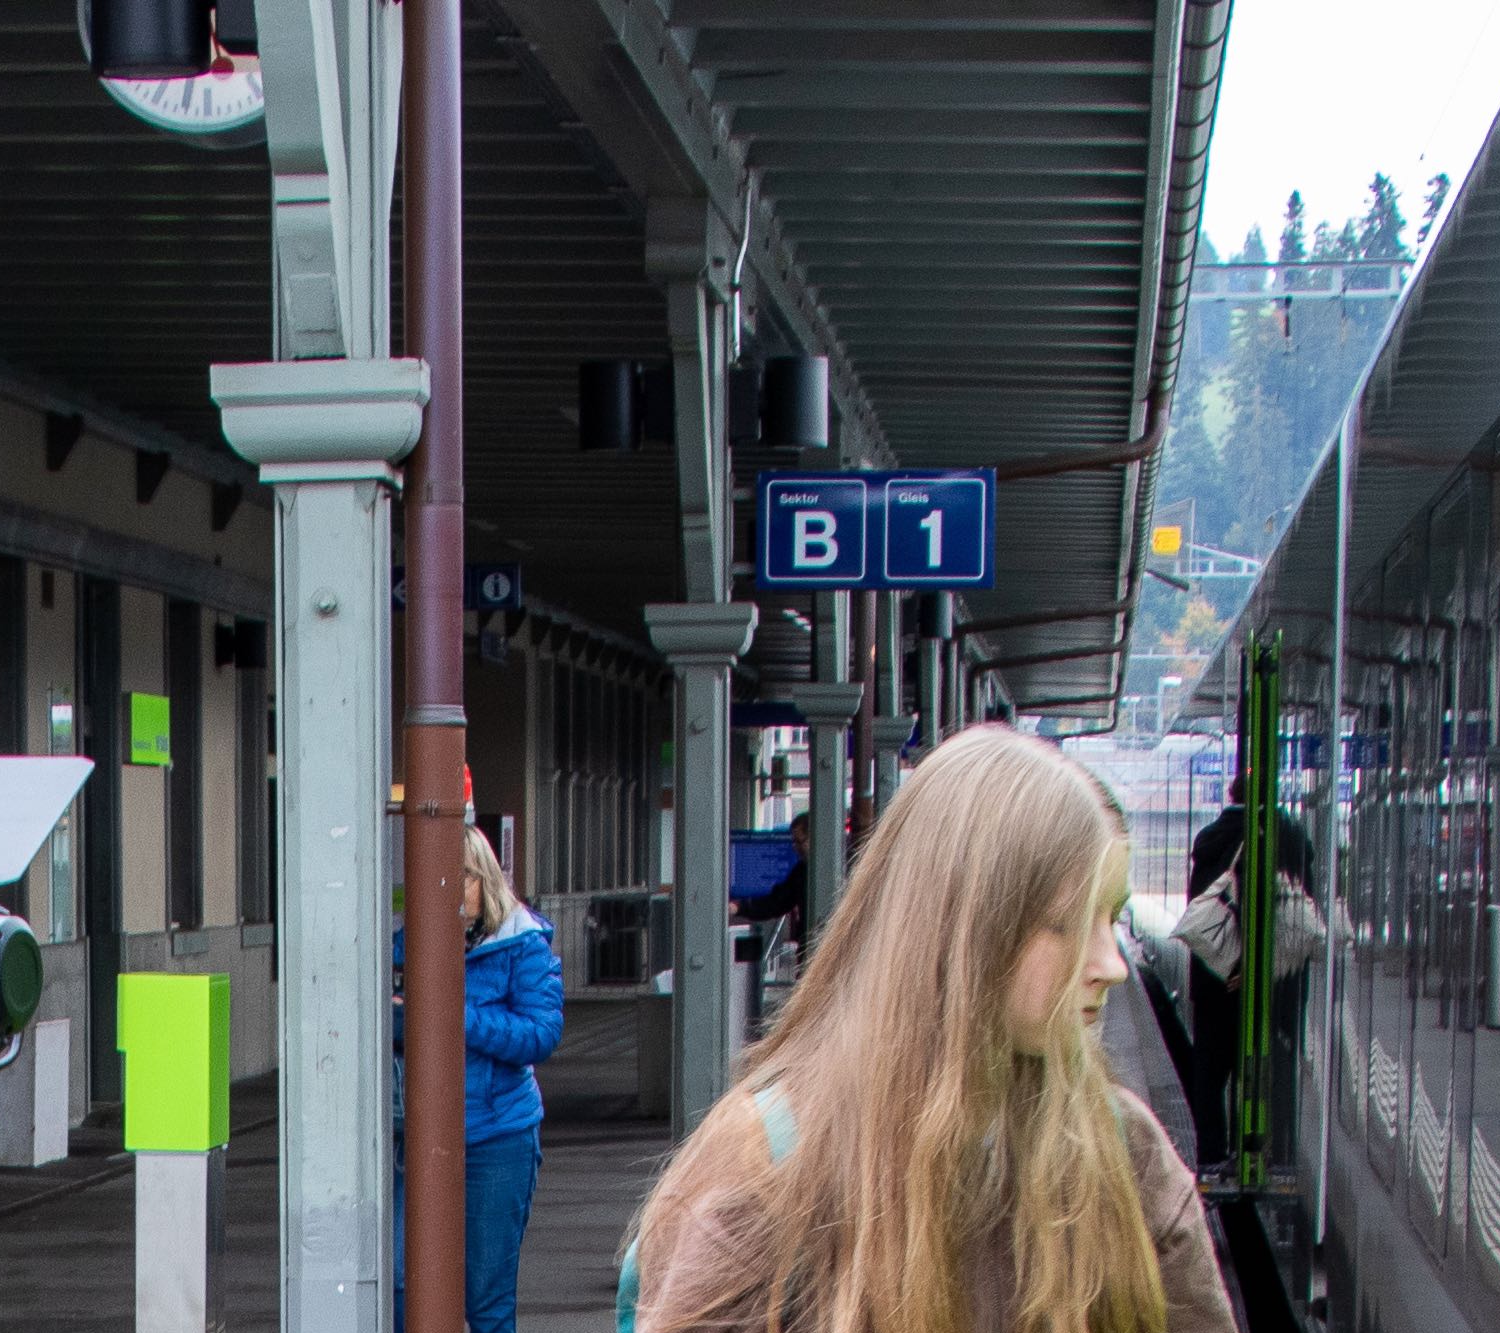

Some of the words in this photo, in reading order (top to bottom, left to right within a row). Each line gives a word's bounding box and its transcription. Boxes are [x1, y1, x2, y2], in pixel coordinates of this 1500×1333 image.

[780, 493, 820, 506] Sektor
[899, 491, 930, 504] Gleis
[794, 510, 839, 568] B
[919, 509, 942, 568] 1
